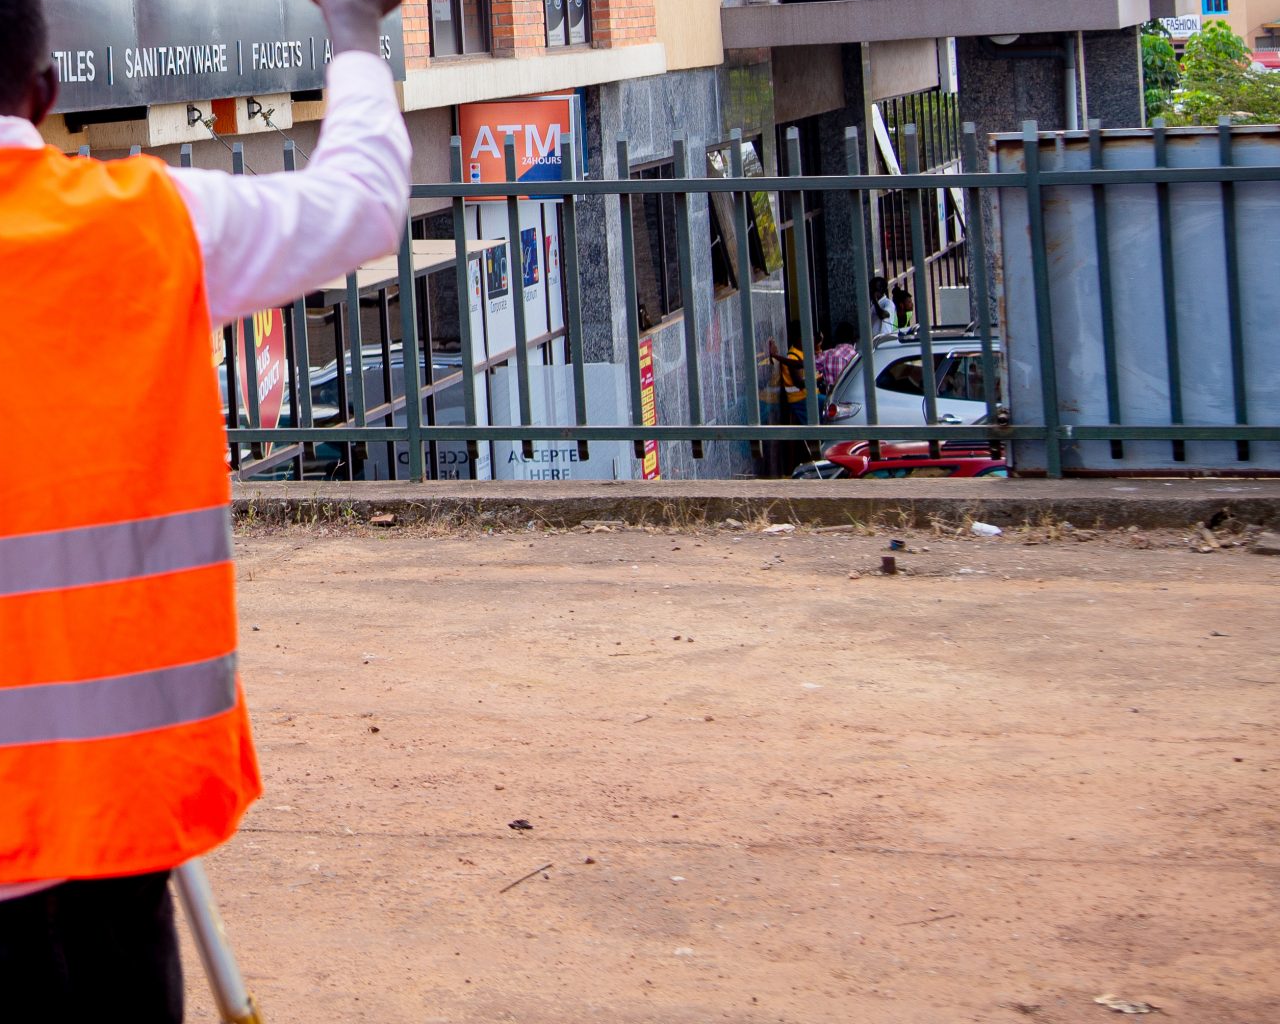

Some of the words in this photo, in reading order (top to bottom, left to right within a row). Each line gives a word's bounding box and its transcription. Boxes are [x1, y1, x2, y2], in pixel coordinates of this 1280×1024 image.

[1166, 19, 1198, 31] FASHION
[125, 44, 228, 79] SANITARYWARE
[252, 40, 303, 70] FAUCETS
[470, 123, 561, 159] ATM
[507, 448, 585, 463] ACCEPTE
